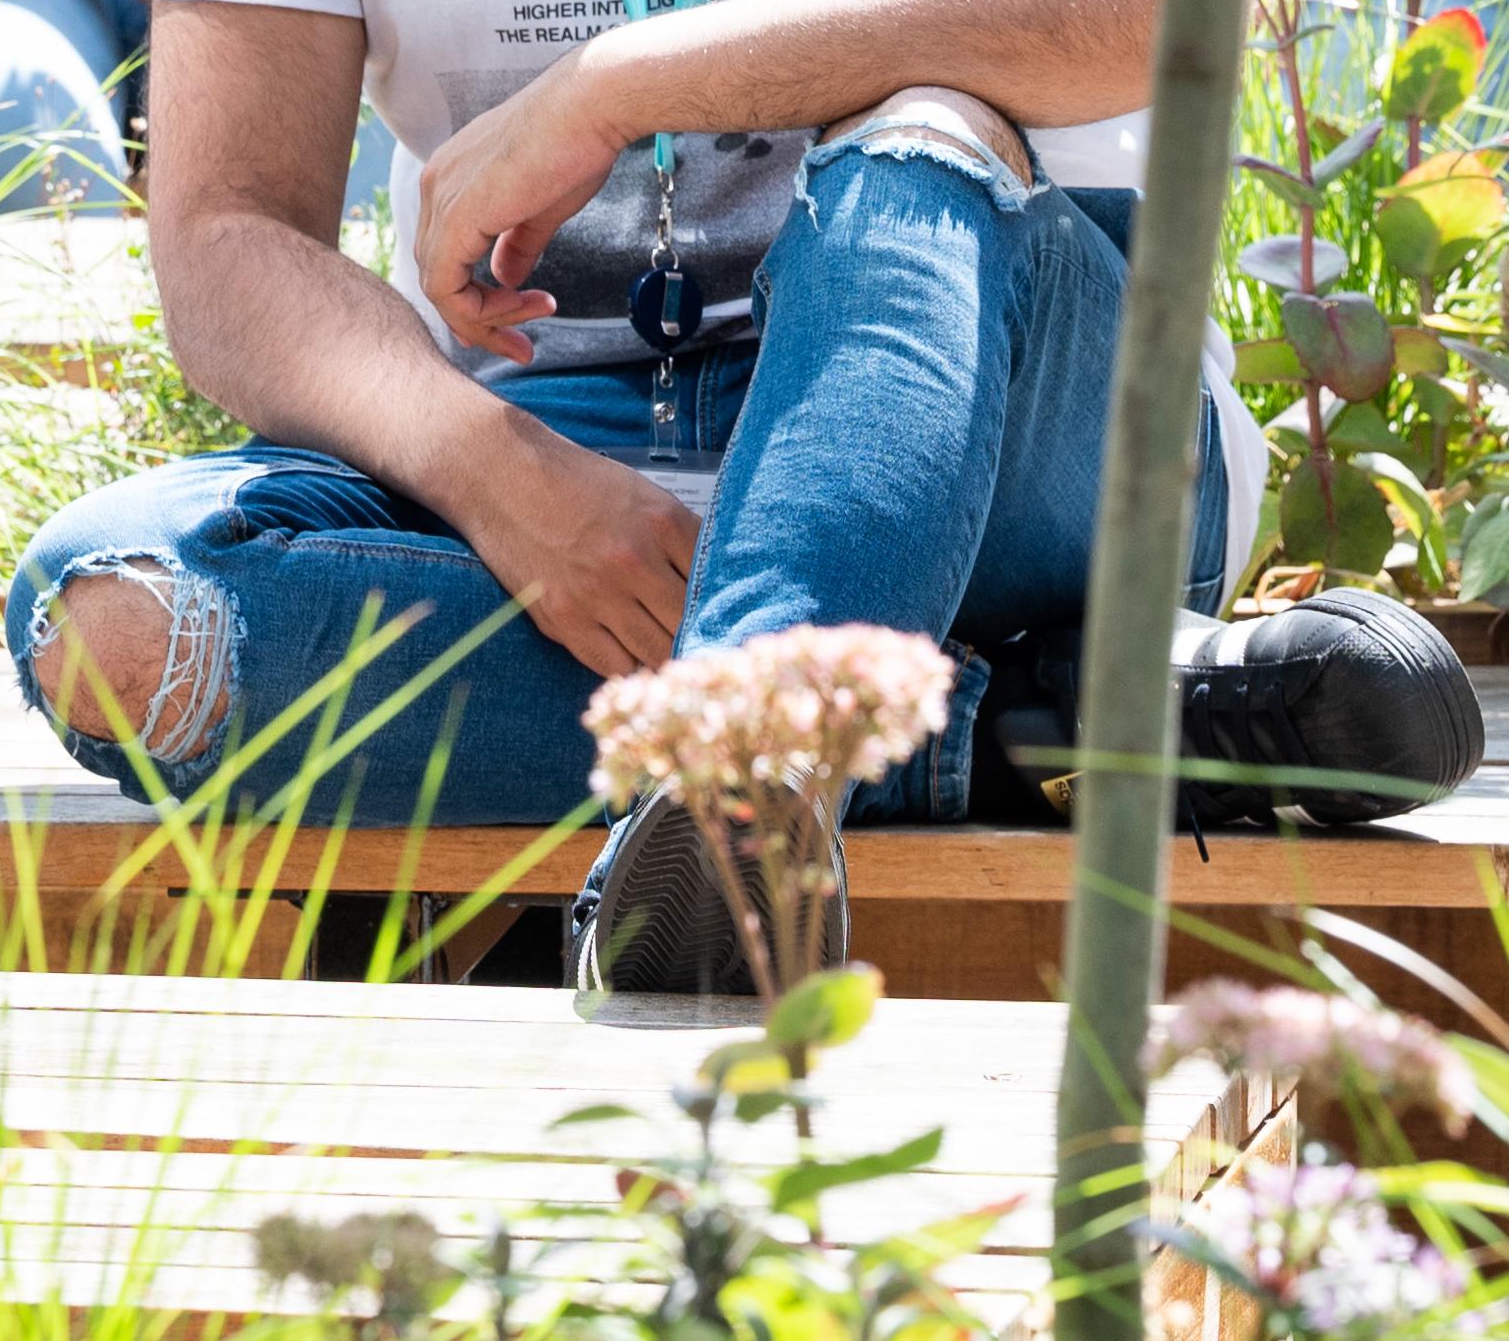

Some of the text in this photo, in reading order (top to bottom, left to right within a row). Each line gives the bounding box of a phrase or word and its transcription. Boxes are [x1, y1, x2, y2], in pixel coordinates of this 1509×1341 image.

[513, 2, 587, 21] HIGHER
[495, 29, 532, 44] THE
[536, 25, 601, 43] REALM
